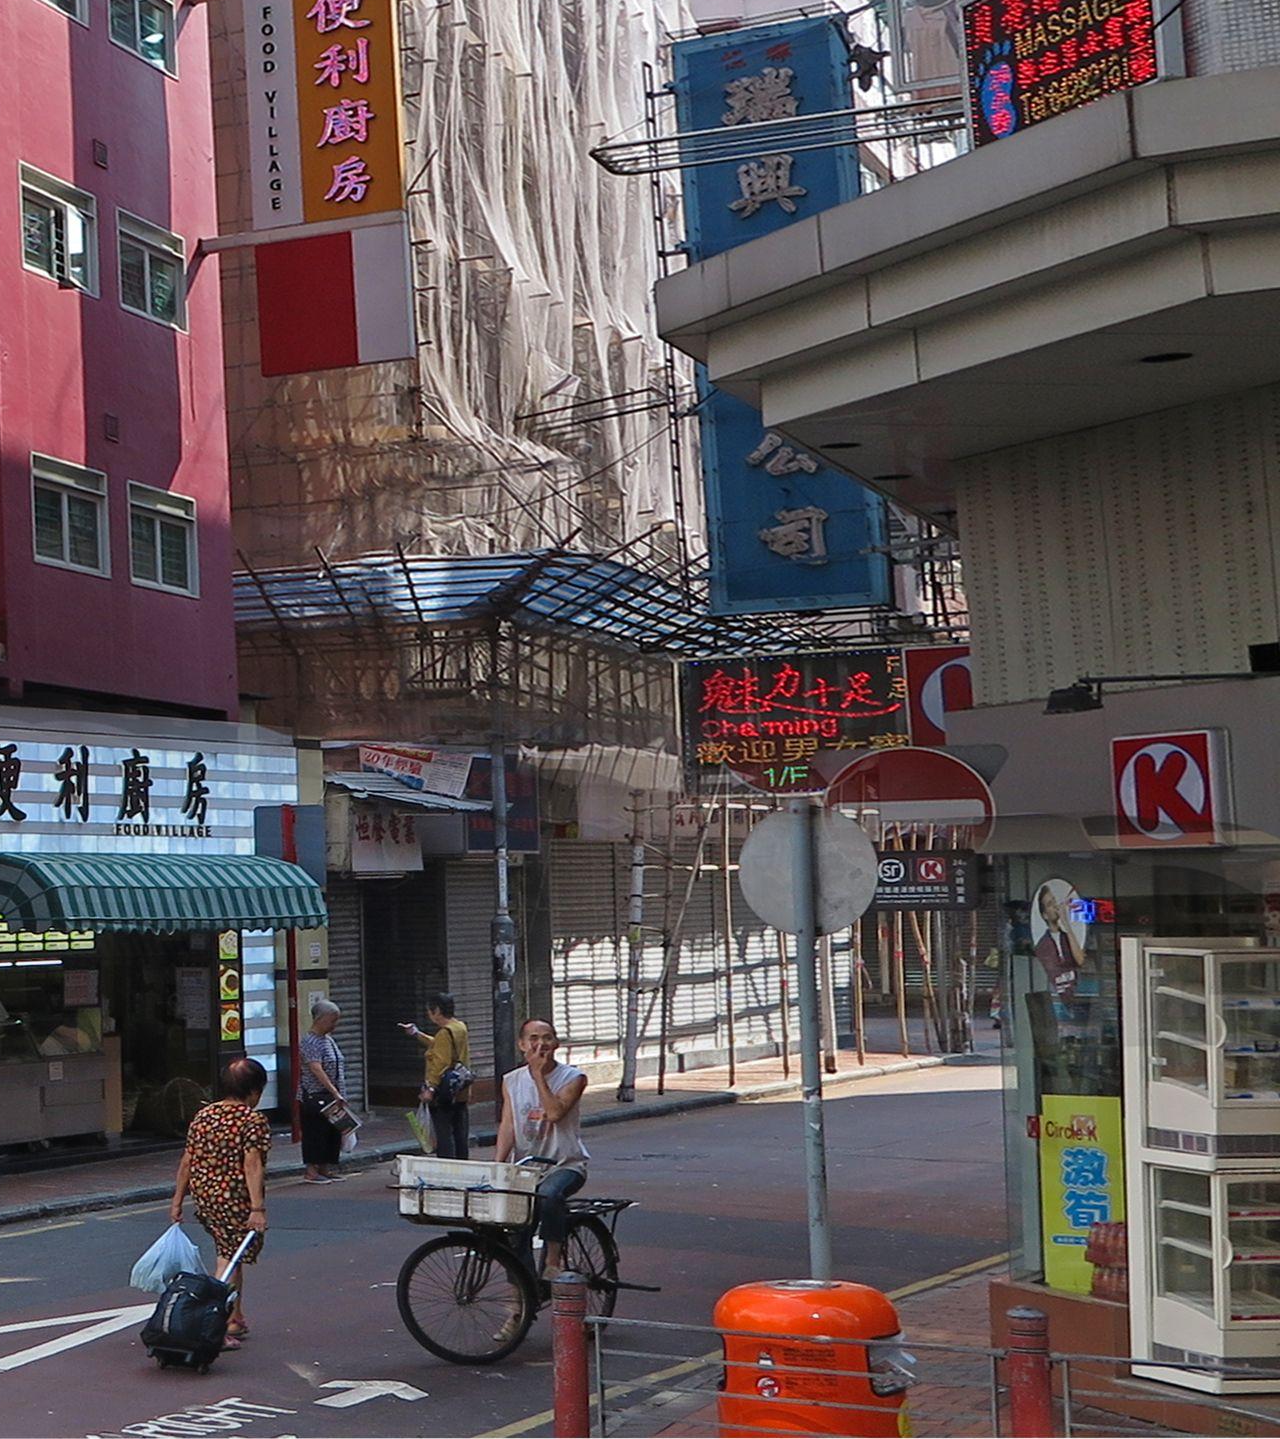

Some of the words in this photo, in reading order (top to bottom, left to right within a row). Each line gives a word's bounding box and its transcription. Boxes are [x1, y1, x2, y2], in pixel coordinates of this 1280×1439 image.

[261, 5, 277, 74] FOOD
[263, 90, 282, 211] VILLAGE
[698, 662, 883, 713] 魅力十足
[762, 766, 809, 788] 1/F
[115, 823, 150, 837] FOOD
[155, 824, 213, 838] VILLAGE
[120, 1396, 298, 1437] RIGHT
